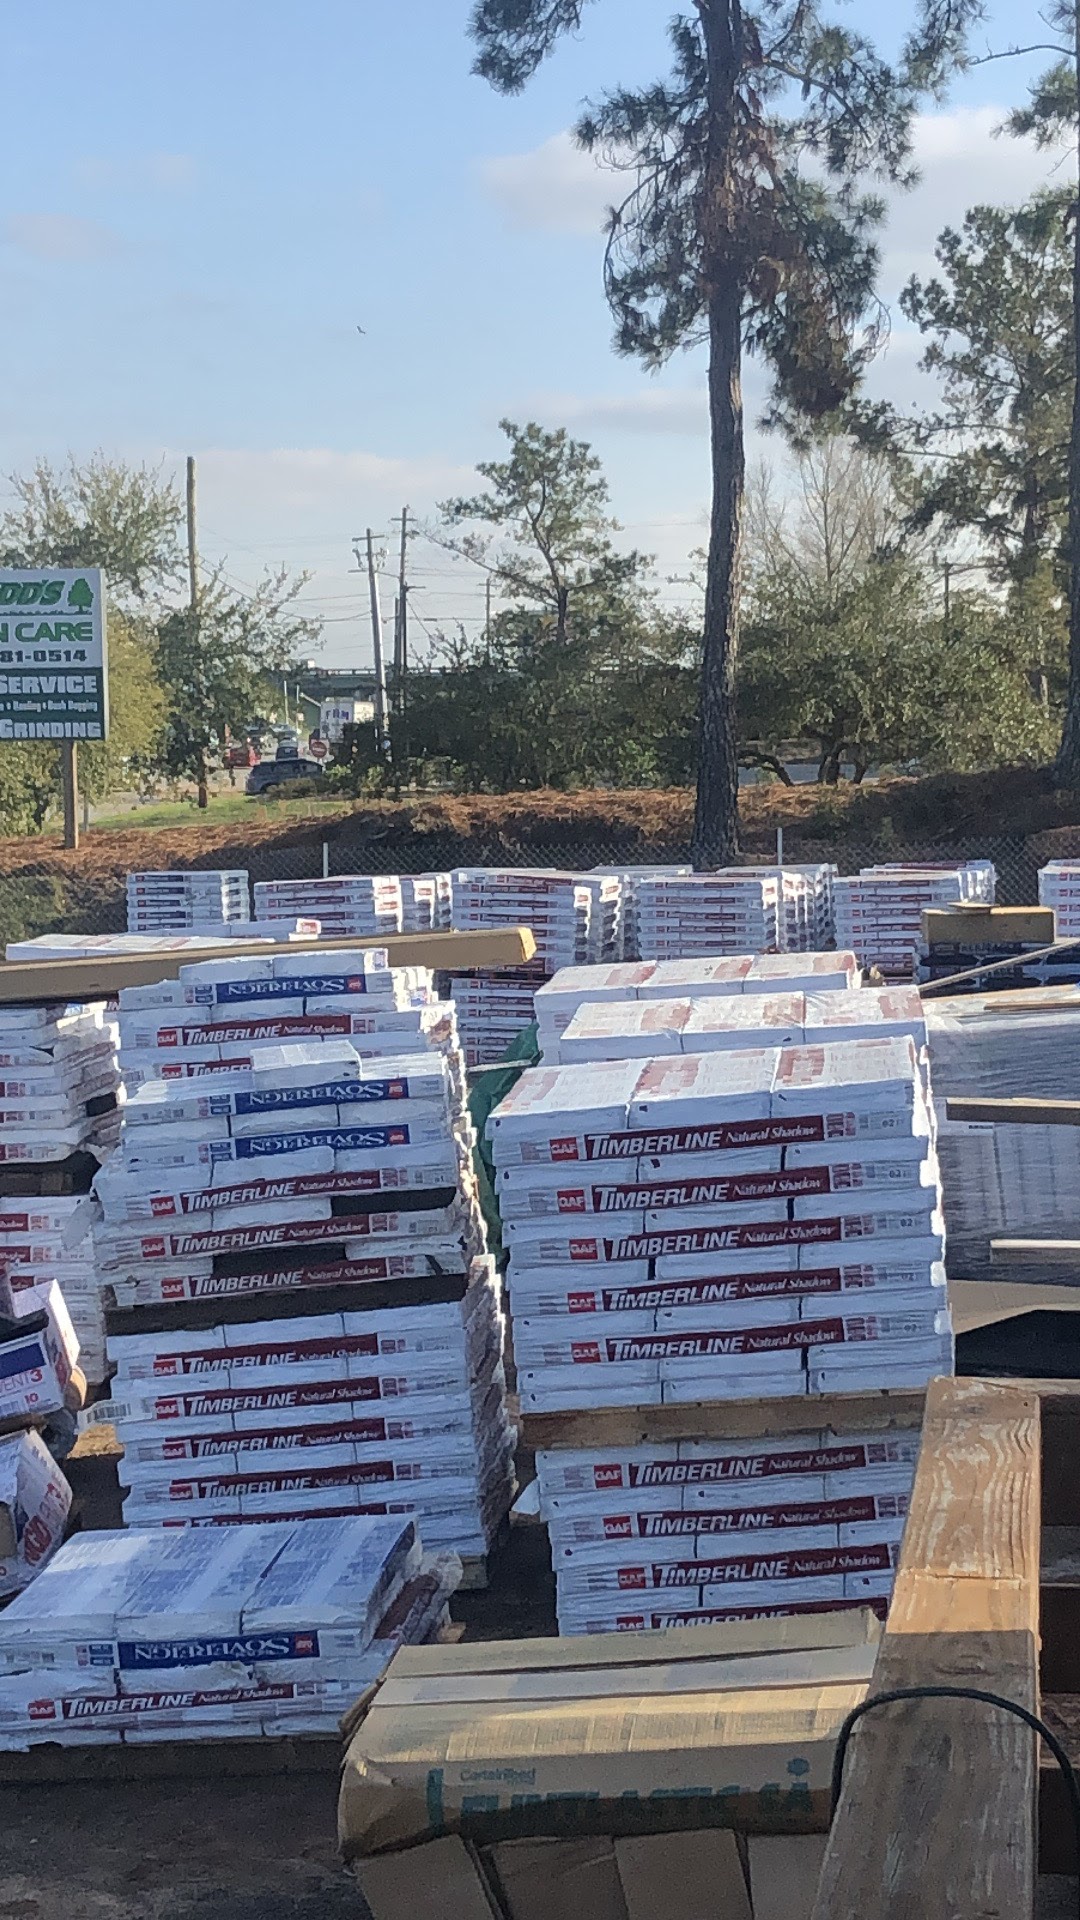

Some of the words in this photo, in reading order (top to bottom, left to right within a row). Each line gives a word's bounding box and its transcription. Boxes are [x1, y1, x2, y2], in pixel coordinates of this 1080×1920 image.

[14, 622, 93, 642] CARE
[0, 675, 98, 694] SERVICE
[0, 718, 101, 738] GRINDING
[184, 1026, 281, 1045] TIMBERLINE
[283, 1024, 312, 1034] Natural
[313, 1024, 345, 1034] Shadow
[189, 1063, 251, 1077] TIMBER
[587, 1128, 723, 1158] TIMBERLINE
[725, 1128, 769, 1143] Natural
[771, 1125, 816, 1138] Shadow
[182, 1182, 296, 1212] TIMBERLINE
[300, 1180, 336, 1191] Natural
[336, 1176, 377, 1187] Shadow
[595, 1183, 730, 1211] TIMBERLINE
[733, 1180, 776, 1196] Natural
[778, 1176, 822, 1191] Shadow
[172, 1227, 287, 1254] TIMBERLINE
[610, 1228, 741, 1258] TIMBERLINE
[744, 1228, 788, 1243] Natural
[788, 1223, 835, 1238] Shadow
[191, 1270, 304, 1296] TIMBERLINE
[307, 1268, 343, 1279] Natural
[344, 1265, 382, 1276] Shadow
[605, 1280, 740, 1310] TIMBERLINE
[743, 1279, 785, 1293] Natural
[787, 1276, 833, 1290] Shadow
[609, 1336, 744, 1360] TIMBERLINE
[747, 1333, 792, 1349] Natural
[793, 1329, 838, 1344] Shadow
[186, 1391, 298, 1416] TIMBERLINE
[301, 1390, 336, 1402] Natural
[337, 1386, 375, 1398] Shadow
[194, 1433, 304, 1456] TIMBERLINE
[631, 1457, 766, 1485] TIMBERLINE
[768, 1455, 813, 1470] Natural
[813, 1452, 858, 1467] Shadow
[640, 1512, 774, 1536] TIMBERLINE
[655, 1556, 789, 1588] TIMBERLINE
[792, 1556, 835, 1572] Natural
[838, 1554, 881, 1568] Shadow
[65, 1692, 197, 1718] TIMBERLINE
[199, 1689, 243, 1702] Natural
[244, 1687, 286, 1699] Shadow
